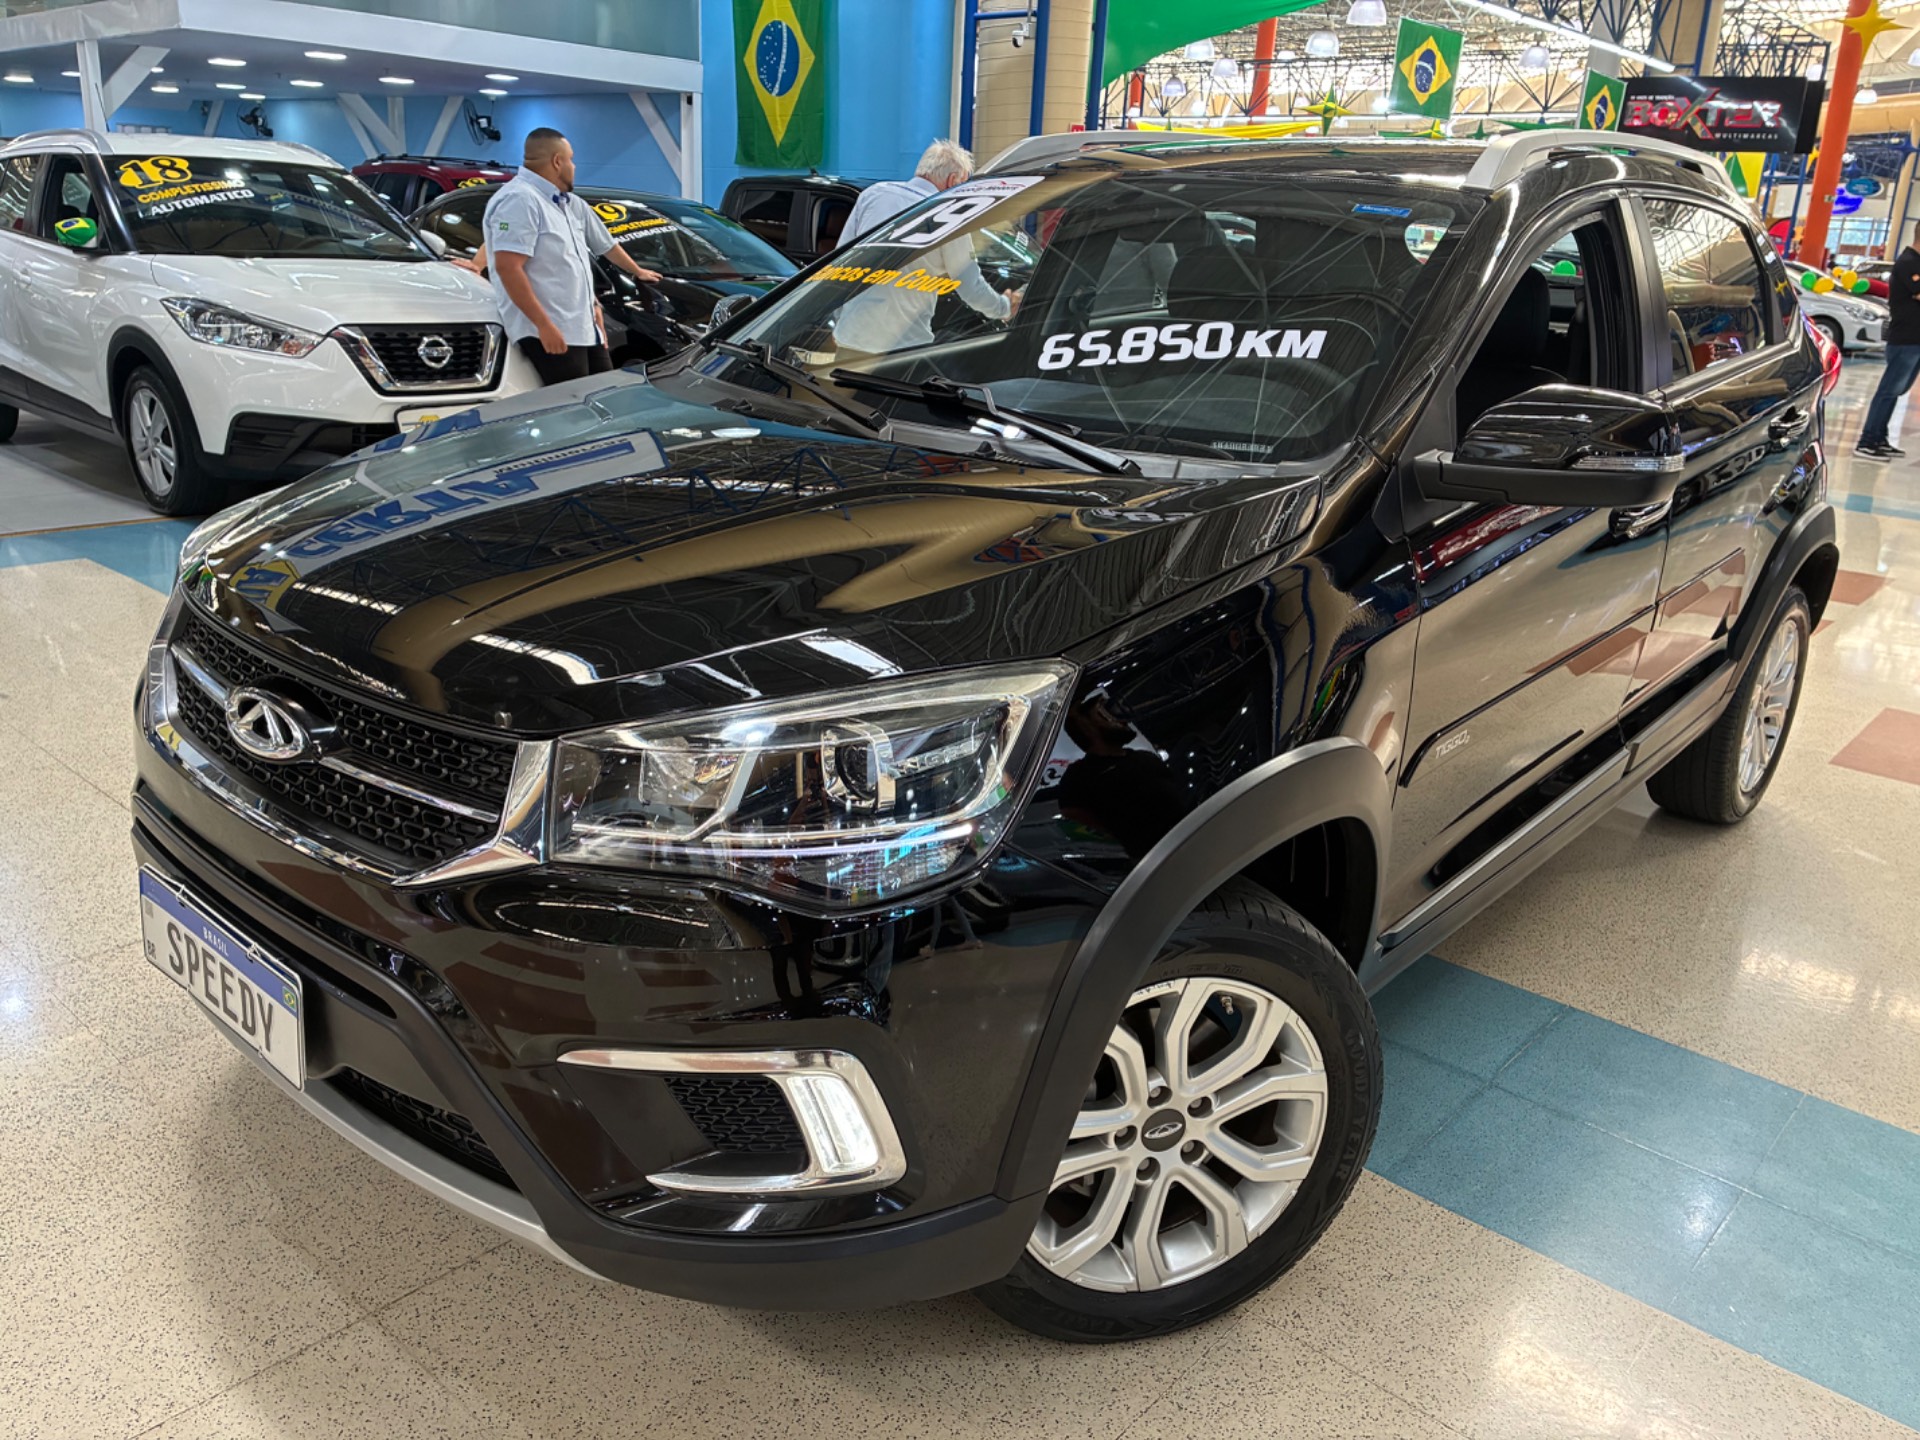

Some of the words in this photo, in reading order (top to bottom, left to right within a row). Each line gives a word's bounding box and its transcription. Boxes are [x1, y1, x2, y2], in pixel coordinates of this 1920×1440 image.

[1624, 87, 1782, 140] BOXTER
[1714, 132, 1779, 141] MULTIMARCAS
[119, 156, 193, 188] 18
[137, 179, 246, 203] COMPLETISSIMO
[150, 188, 255, 216] AUTOMATICO
[890, 196, 996, 244] 19
[861, 269, 902, 285] em
[894, 268, 962, 295] Couro
[202, 926, 229, 957] BRASIL
[166, 921, 274, 1053] SPEEDY
